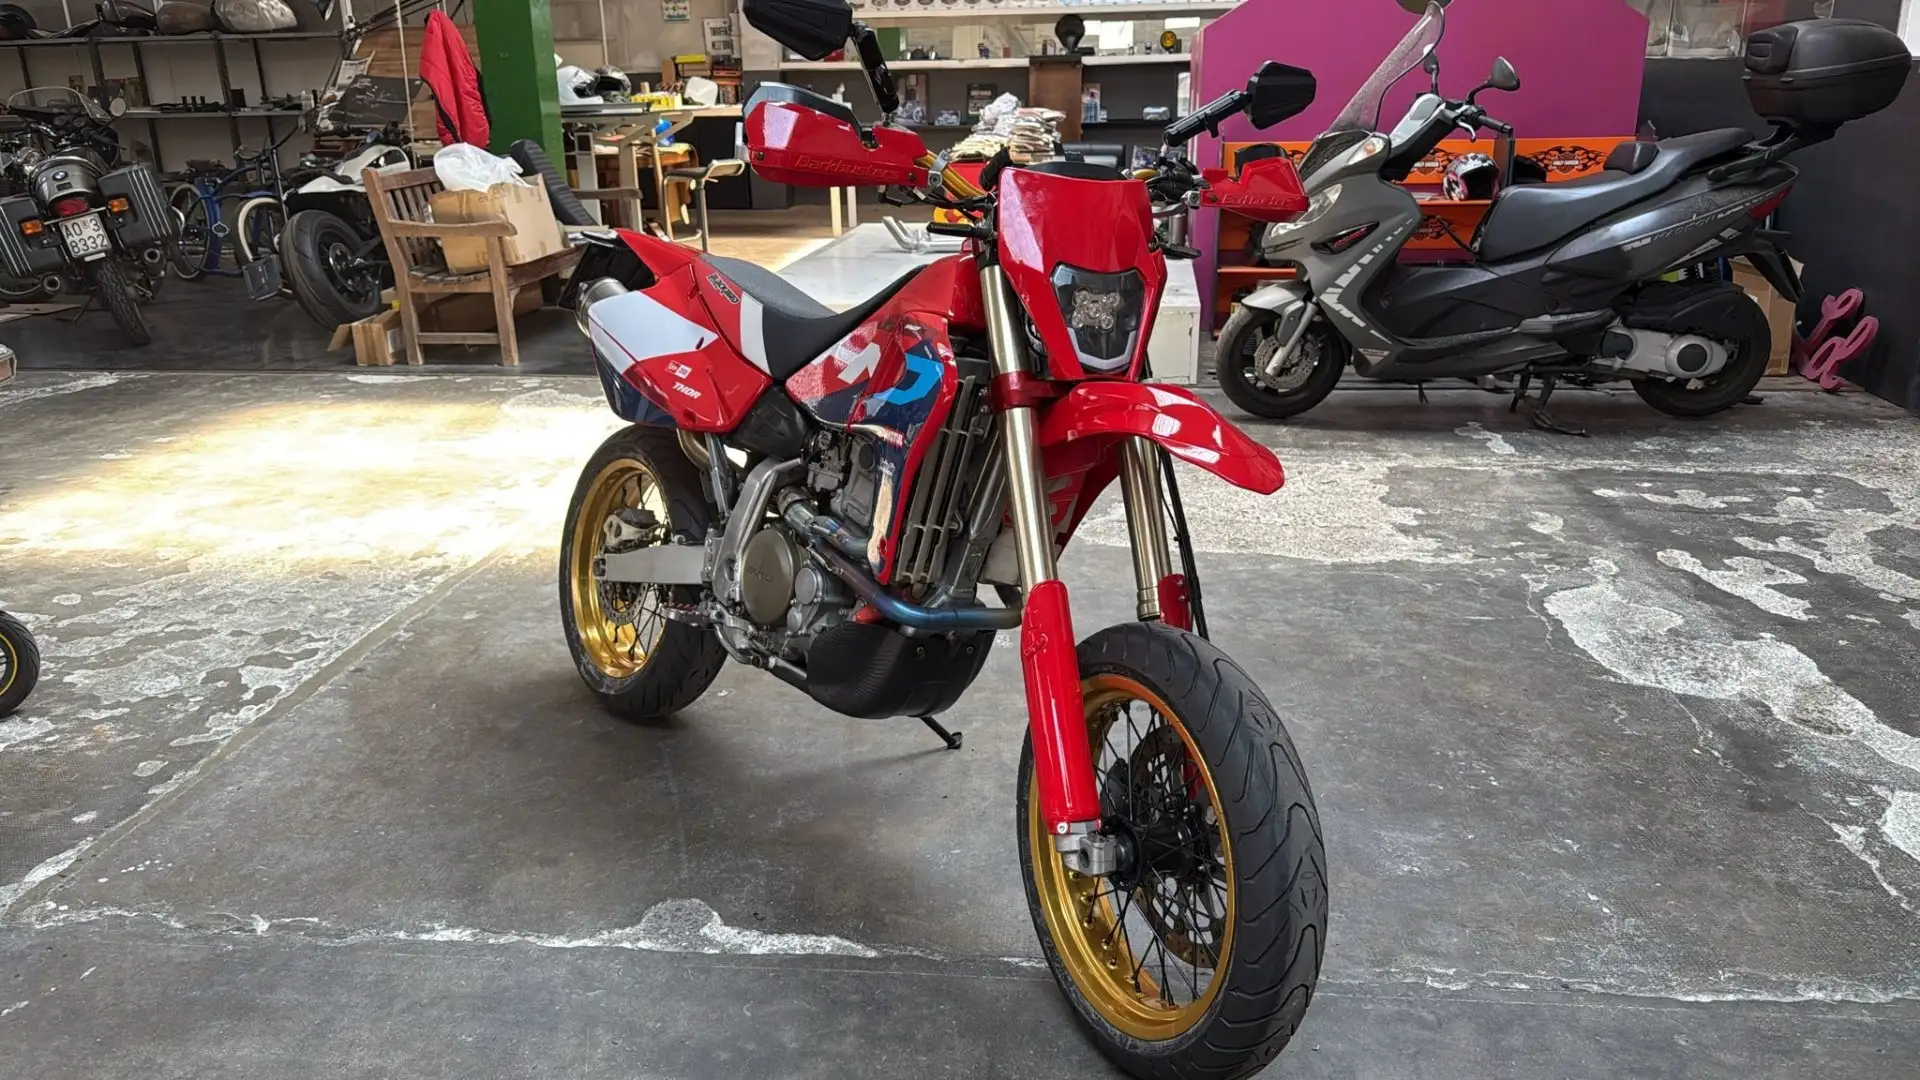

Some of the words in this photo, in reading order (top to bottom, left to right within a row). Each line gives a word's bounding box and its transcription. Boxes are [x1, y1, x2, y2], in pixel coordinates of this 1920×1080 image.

[90, 218, 101, 232] 3
[70, 234, 109, 254] 8332
[672, 381, 702, 400] THOR
